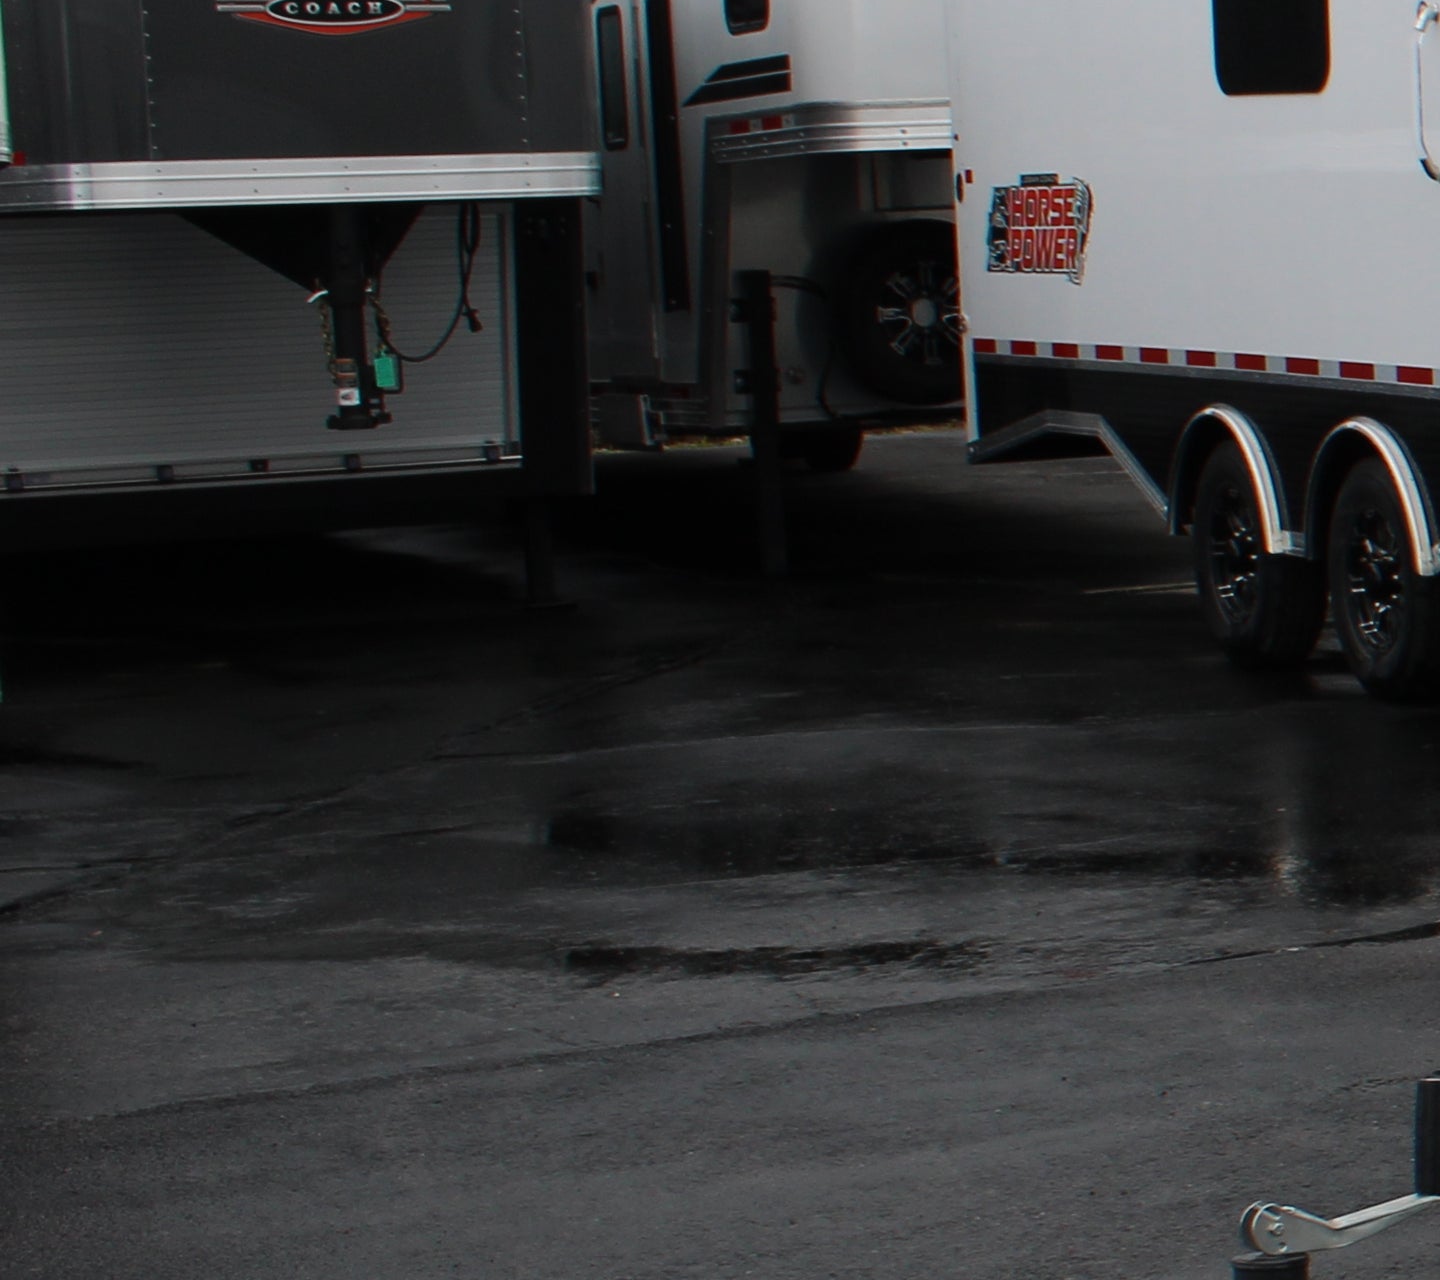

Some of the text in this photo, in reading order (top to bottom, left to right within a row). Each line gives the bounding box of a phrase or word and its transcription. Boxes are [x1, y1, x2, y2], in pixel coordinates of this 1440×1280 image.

[284, 1, 383, 16] COACH
[1008, 186, 1077, 227] HORSE
[1008, 227, 1079, 271] POWER
